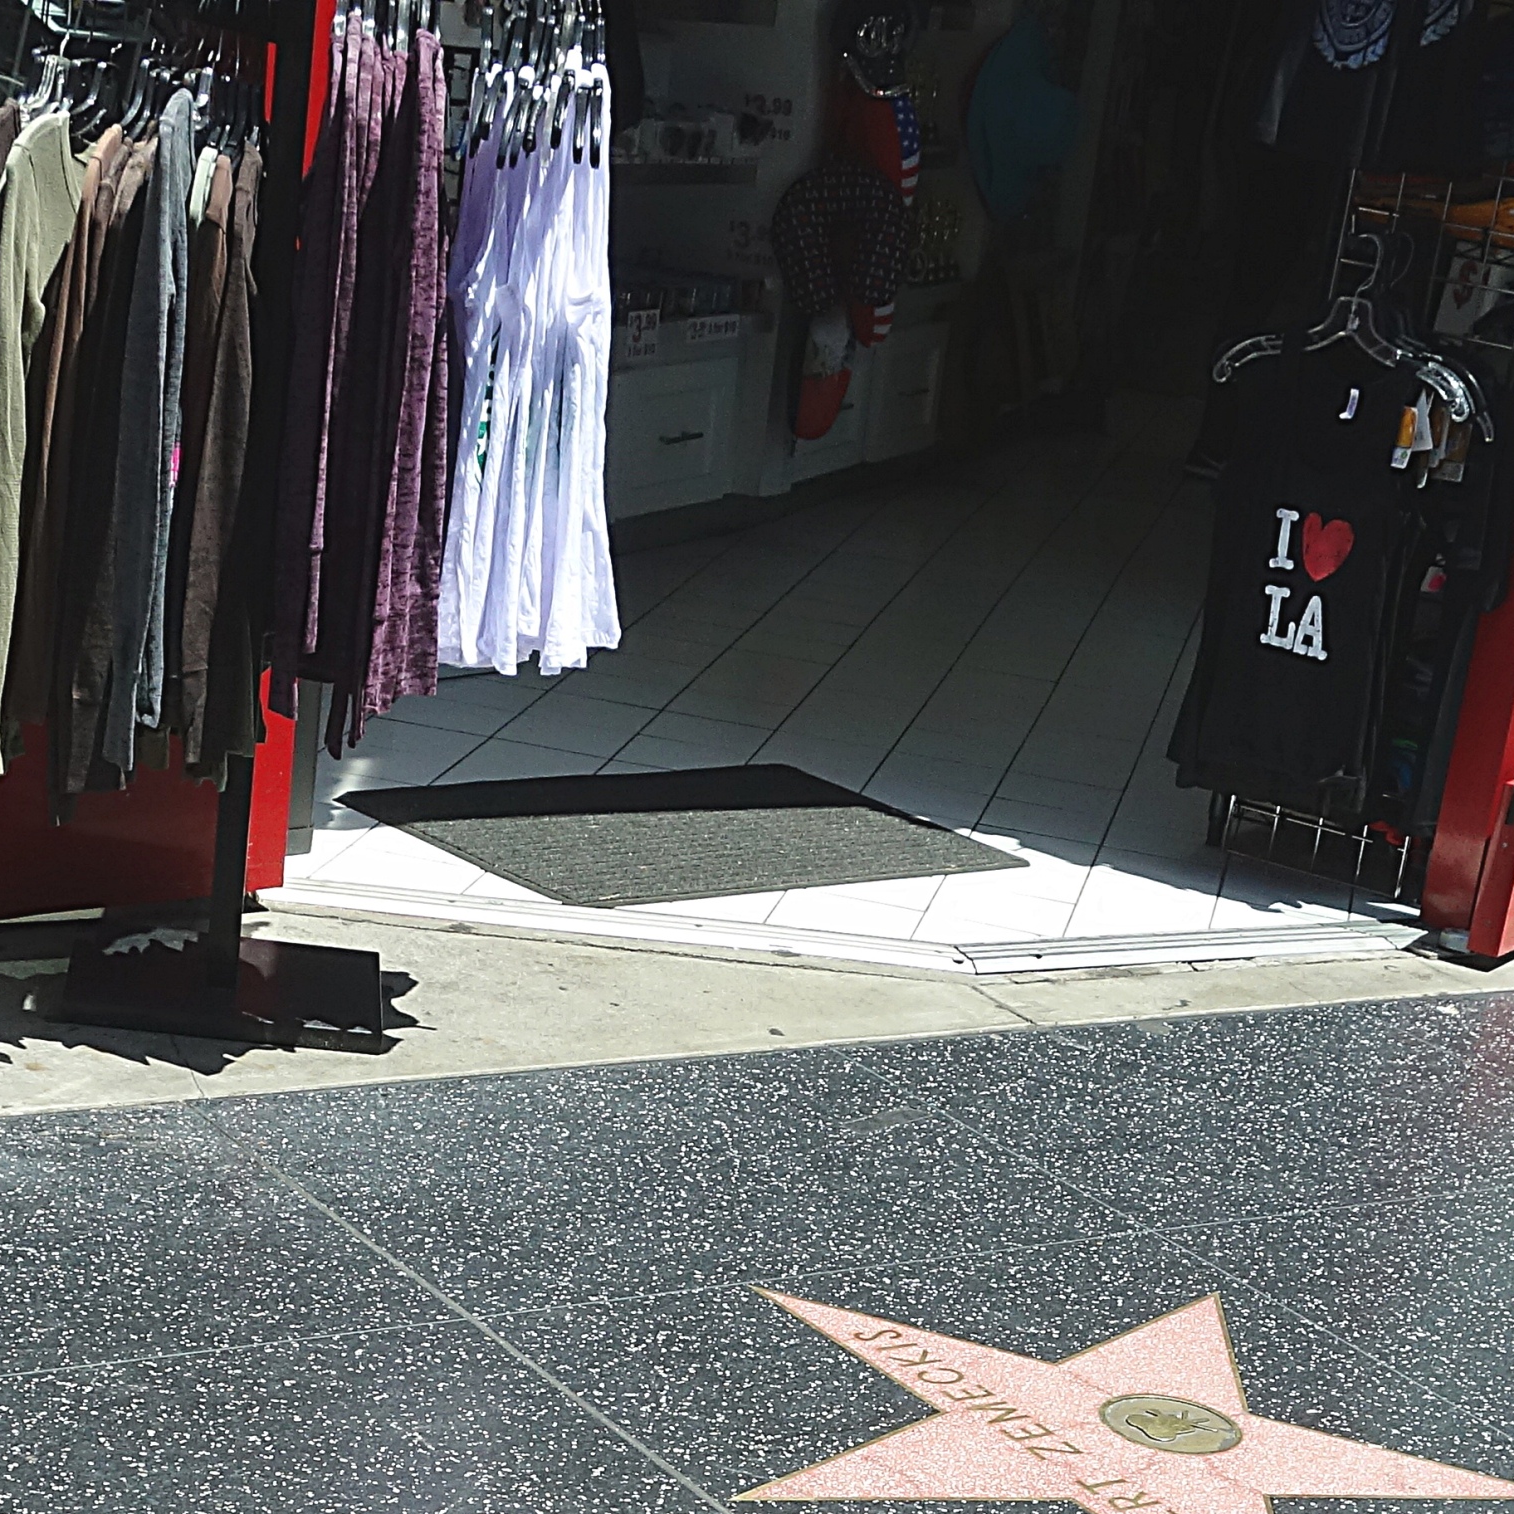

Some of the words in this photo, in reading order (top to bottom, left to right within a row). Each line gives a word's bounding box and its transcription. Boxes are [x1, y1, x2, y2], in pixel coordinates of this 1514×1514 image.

[1269, 508, 1299, 570] I
[1259, 584, 1328, 662] LA
[853, 1328, 1086, 1461] ZEMECKIS
